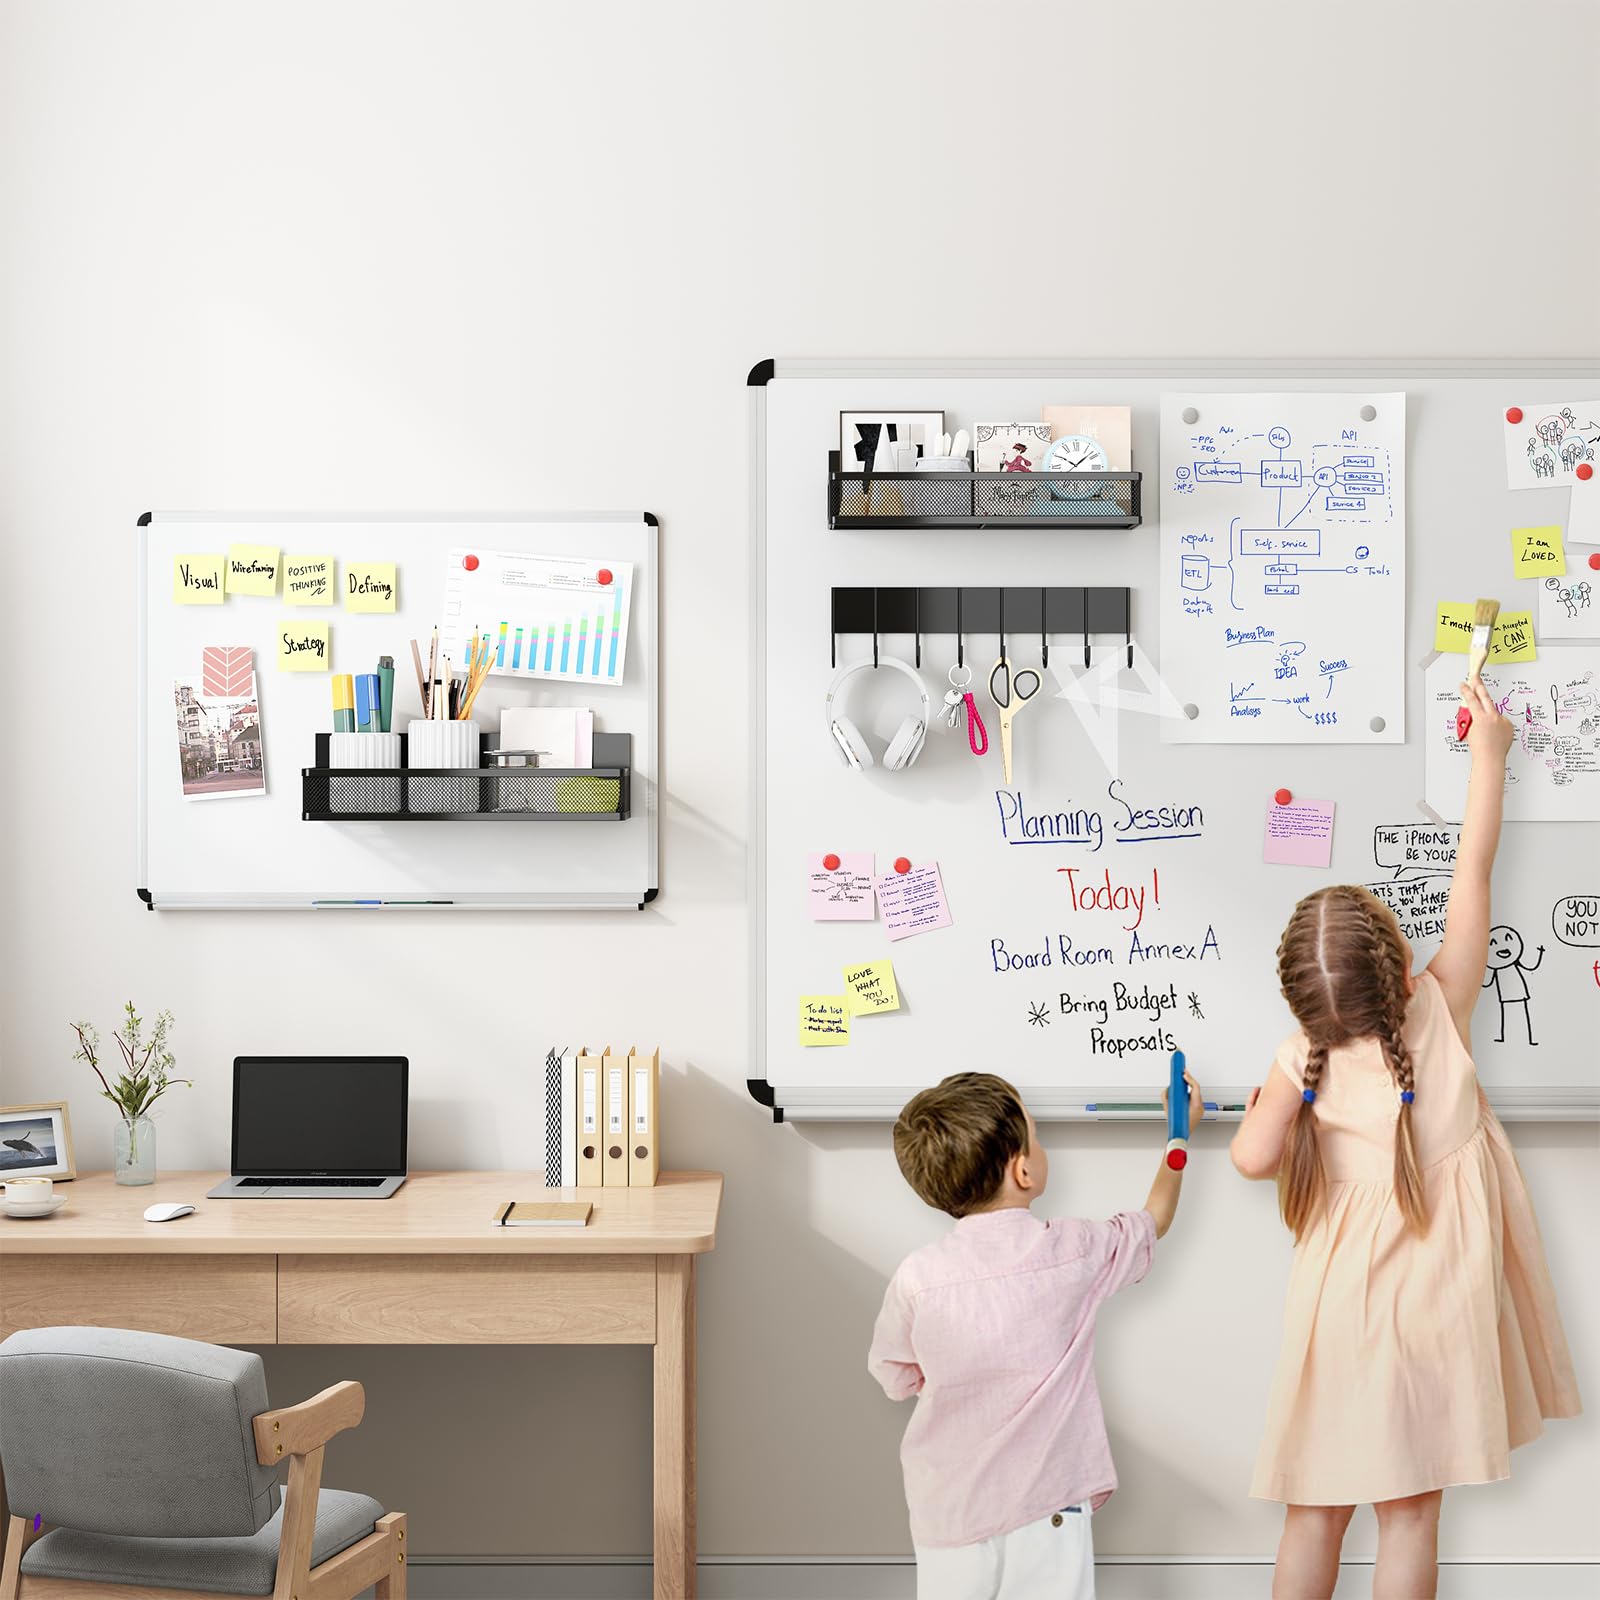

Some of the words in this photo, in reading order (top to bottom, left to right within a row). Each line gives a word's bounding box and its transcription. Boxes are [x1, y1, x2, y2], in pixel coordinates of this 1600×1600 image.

[1342, 430, 1357, 440] API
[1264, 468, 1298, 482] Product
[1318, 473, 1328, 481] API
[1527, 537, 1533, 545] I
[288, 563, 326, 576] POSITIVE
[1185, 569, 1202, 578] ETL
[1345, 566, 1358, 574] CS
[1367, 565, 1390, 576] Tools
[180, 564, 218, 590] Visual
[290, 578, 326, 590] THINKING
[349, 574, 392, 600] Defining
[1441, 616, 1450, 625] I
[1450, 621, 1474, 633] matt
[1502, 618, 1528, 631] Accepted
[1225, 628, 1256, 642] Business
[1256, 626, 1274, 637] Plan
[284, 634, 325, 658] Strategy
[1492, 645, 1501, 654] I
[1319, 659, 1348, 673] Success
[1274, 667, 1298, 680] IDEA
[1293, 694, 1310, 704] work
[1314, 712, 1338, 725] $$$$
[996, 790, 1104, 852] Planning
[1108, 779, 1203, 831] Session
[1377, 832, 1399, 843] THE
[1405, 831, 1451, 845] iPHONE
[1406, 849, 1419, 860] BE
[1424, 849, 1456, 862] YOUR
[1398, 882, 1428, 896] THAT
[1057, 868, 1161, 930] Today!
[1399, 896, 1414, 906] YOU
[1566, 900, 1597, 918] YOU
[1566, 921, 1599, 936] NOT
[991, 936, 1052, 972] Board
[1059, 934, 1113, 966] Room
[1129, 931, 1196, 965] Annex
[1200, 924, 1221, 960] A
[847, 968, 873, 983] LOVE
[855, 978, 880, 992] WHAT
[863, 990, 883, 1000] YOU
[818, 1005, 827, 1013] do
[831, 1006, 843, 1014] list
[1060, 993, 1108, 1024] Bring
[1113, 982, 1177, 1022] Budget
[1091, 1028, 1177, 1058] Proposals
